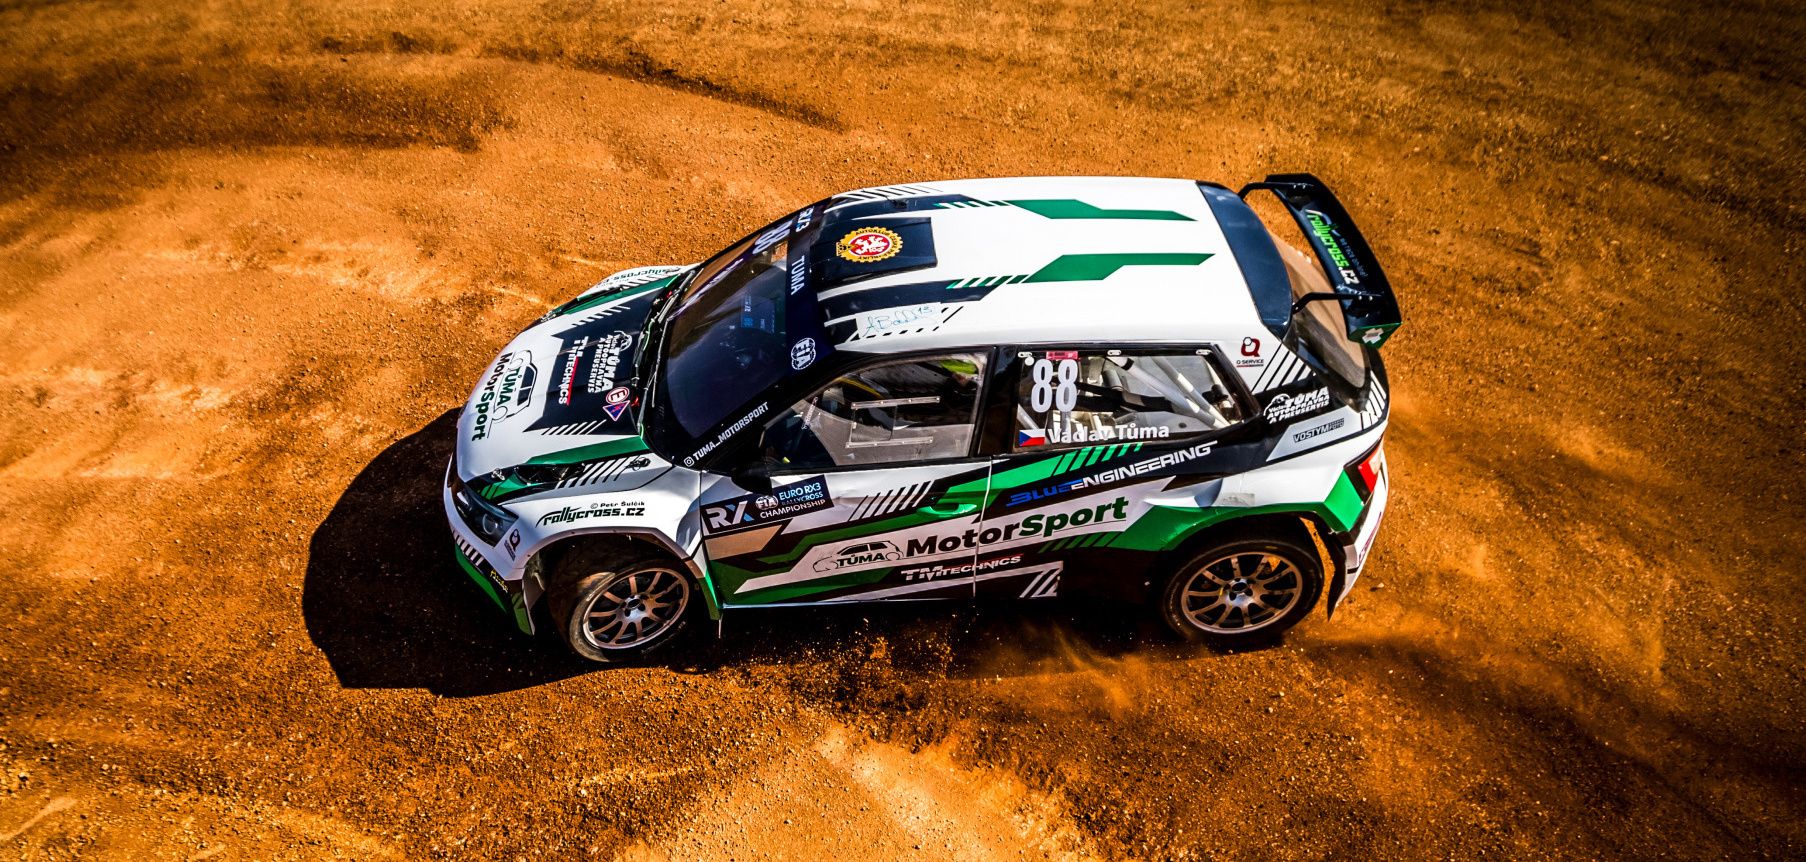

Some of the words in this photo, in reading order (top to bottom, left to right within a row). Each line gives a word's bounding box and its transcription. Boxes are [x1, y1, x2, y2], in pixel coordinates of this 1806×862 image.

[1307, 213, 1360, 285] rallycross.cz
[790, 255, 805, 296] TUMA
[600, 347, 621, 392] TŮMA
[472, 352, 513, 442] MotorSport
[497, 367, 521, 406] TŮMA
[1031, 358, 1079, 413] 88
[1285, 386, 1330, 408] TŮMA
[693, 401, 769, 461] TUMA_MOTORSPORT
[1115, 422, 1170, 440] Tůma
[1293, 422, 1329, 442] VOSTYM
[779, 487, 804, 501] EURO
[804, 482, 821, 494] RX3
[782, 491, 823, 505] RALLYCROSS
[541, 507, 645, 527] rallycross.cz
[706, 501, 754, 529] RX
[760, 499, 826, 519] CHAMPIONSHIP
[906, 496, 1129, 558] MotorSport
[837, 551, 885, 567] TŮMA
